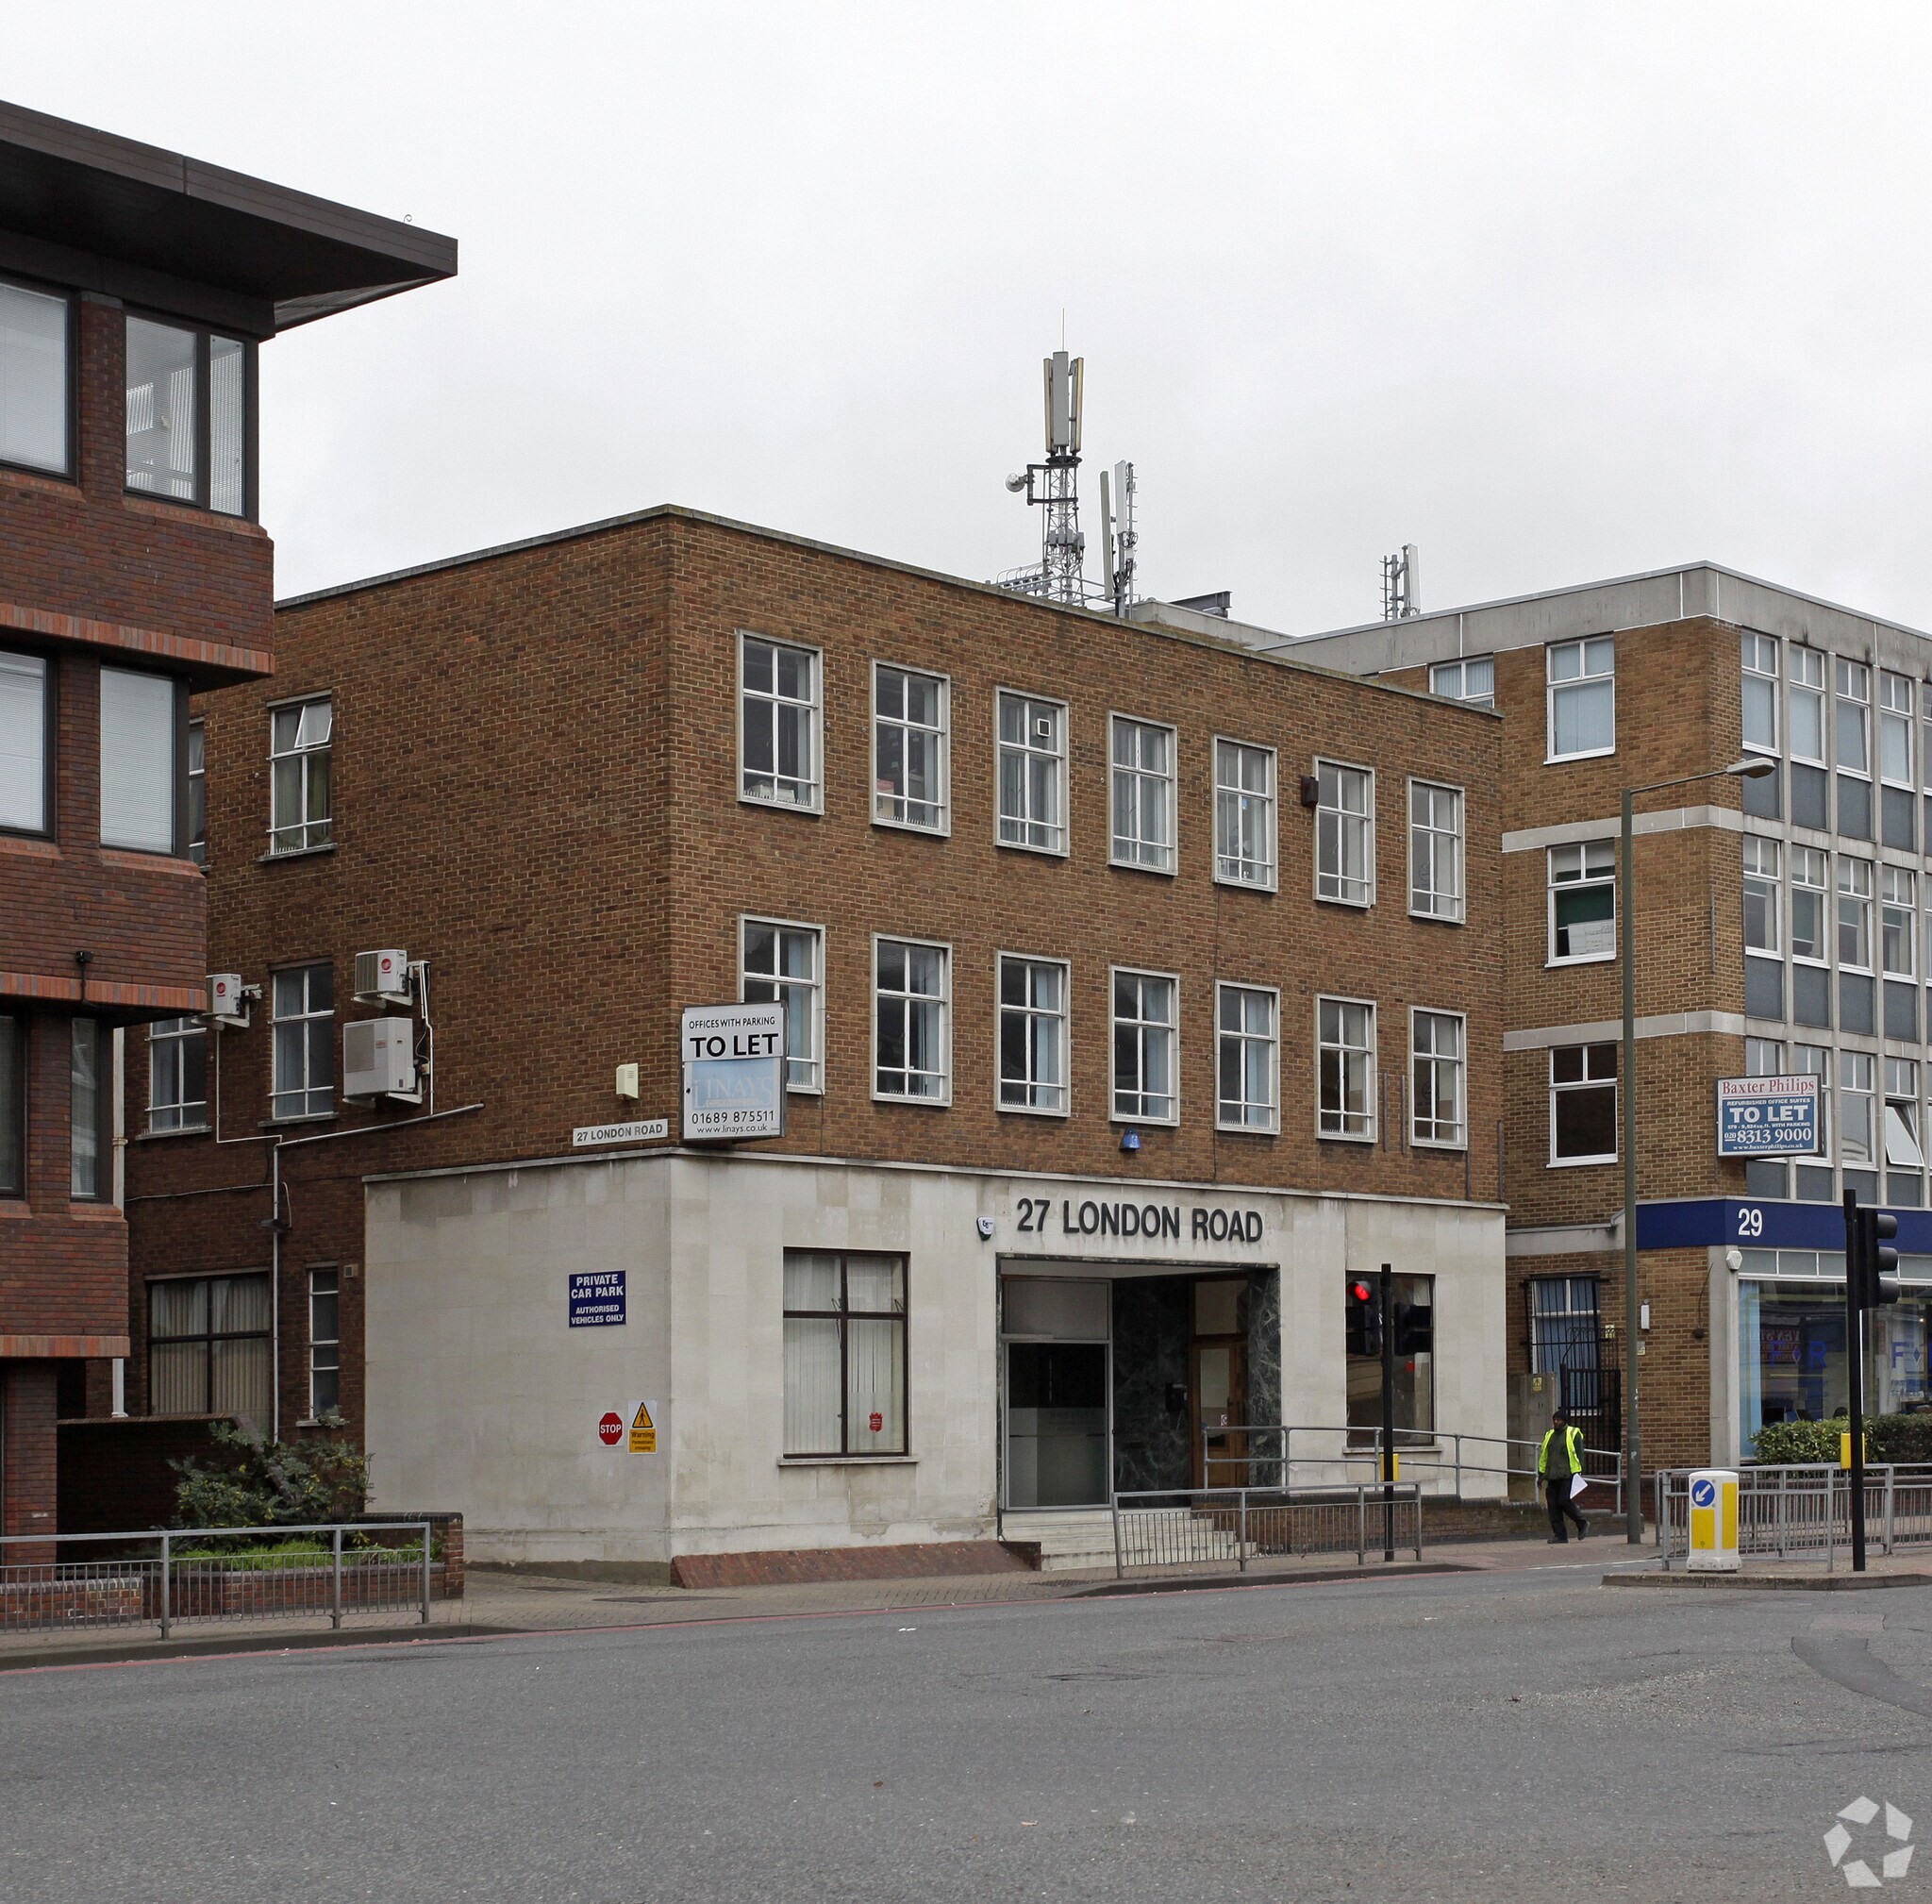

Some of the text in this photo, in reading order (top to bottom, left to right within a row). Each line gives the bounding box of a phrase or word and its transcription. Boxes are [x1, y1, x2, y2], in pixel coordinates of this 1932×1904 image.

[689, 1016, 775, 1029] OFFICES WITH PARKING
[690, 1033, 779, 1058] TO LET
[693, 1076, 774, 1109] LINAYS
[1722, 1077, 1815, 1095] Baxter Philips
[691, 1110, 774, 1125] 01689 875511
[1729, 1104, 1808, 1124] TO LET
[576, 1124, 663, 1142] 27 LONDON ROAD
[696, 1124, 768, 1135] www.linays.co.uk
[1737, 1128, 1772, 1144] 8313
[1774, 1127, 1812, 1144] 9000
[1017, 1197, 1264, 1243] 27 LONDON ROAD
[1738, 1208, 1763, 1237] 29
[576, 1274, 619, 1287] PRIVATE
[571, 1286, 625, 1299] CAR PARK
[575, 1305, 620, 1314] AUTHORISED
[571, 1313, 625, 1325] VEHICLES ONLY
[600, 1424, 622, 1434] STOP
